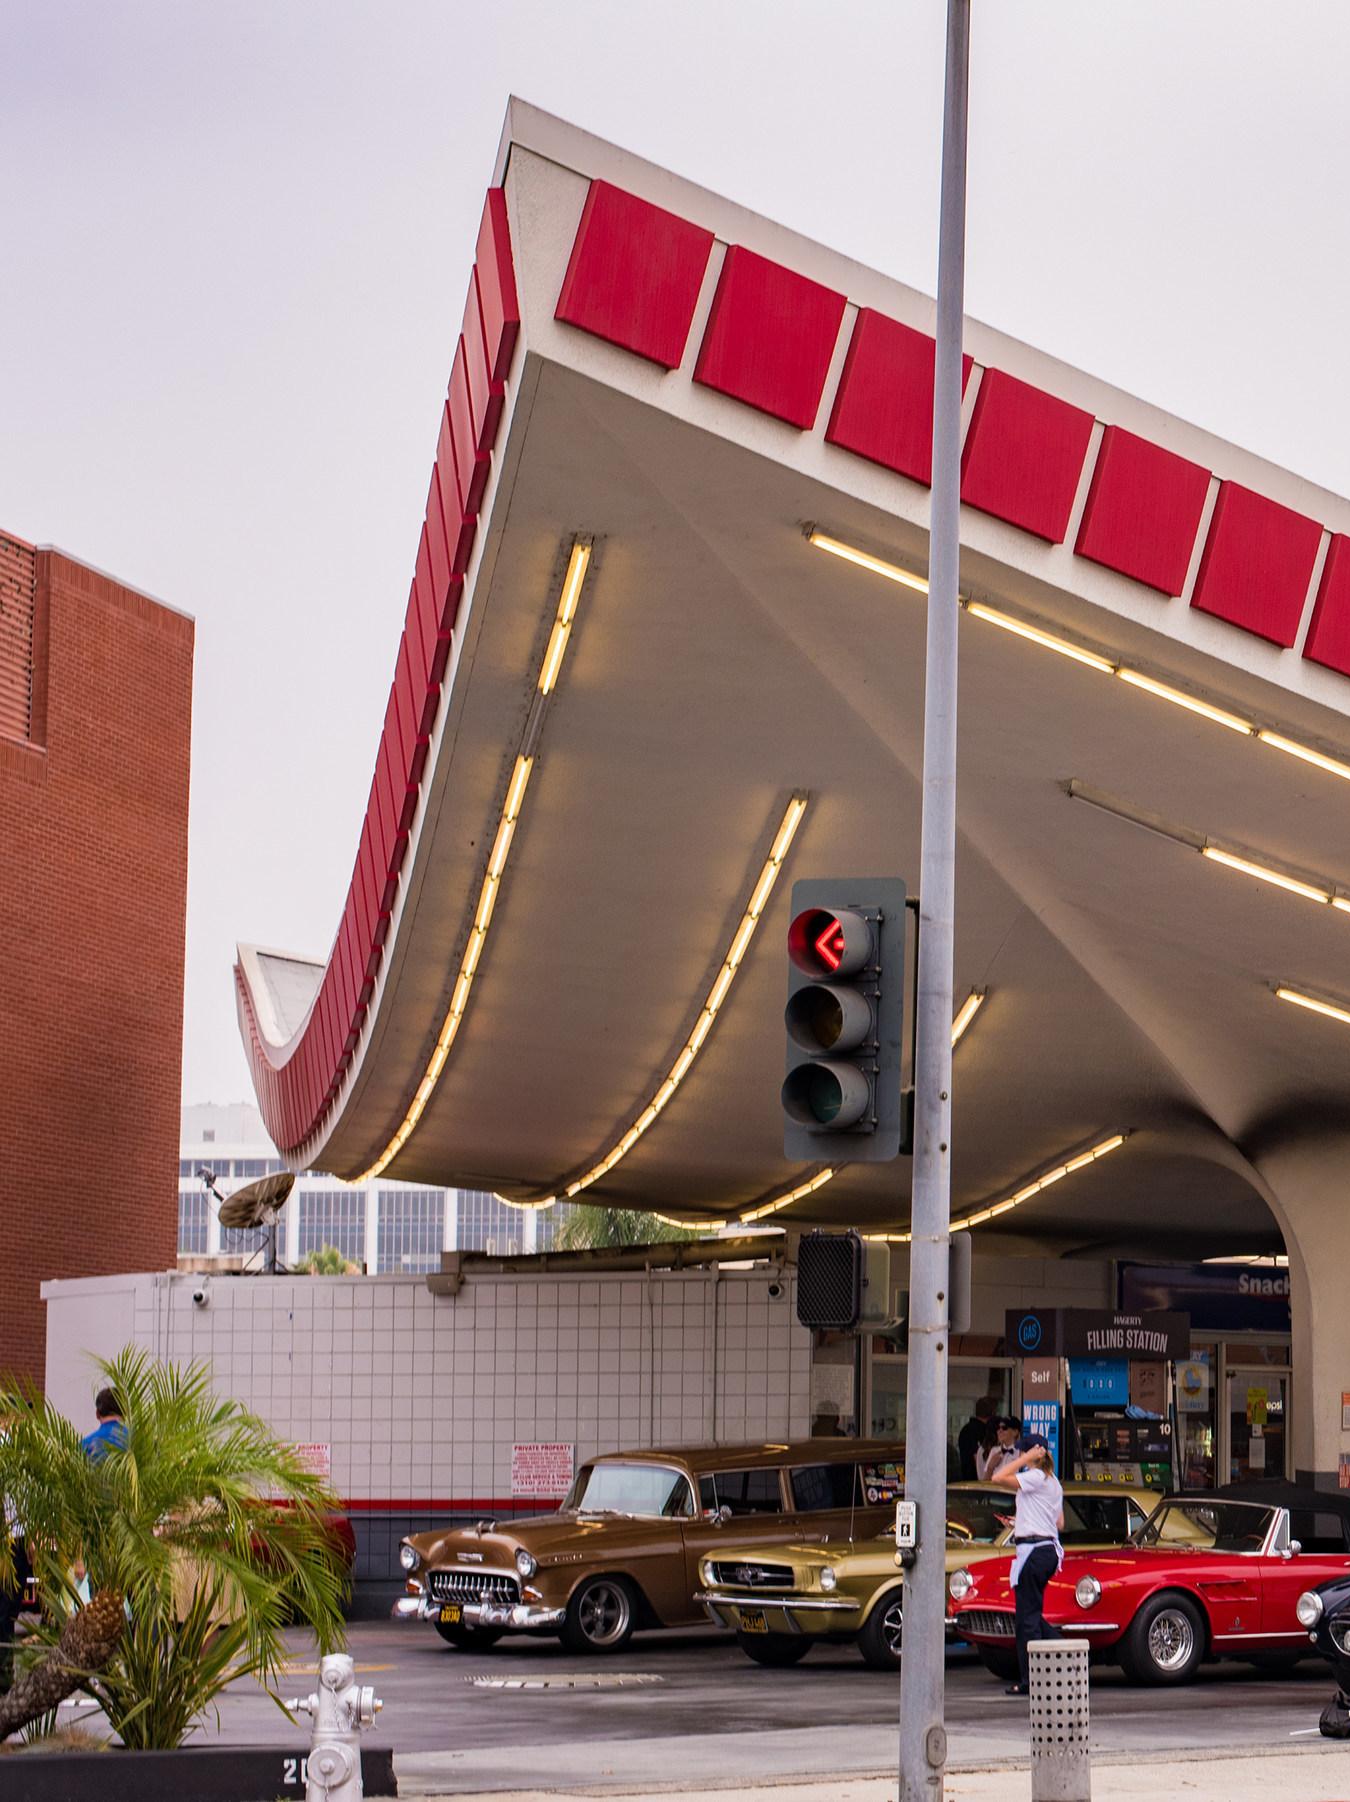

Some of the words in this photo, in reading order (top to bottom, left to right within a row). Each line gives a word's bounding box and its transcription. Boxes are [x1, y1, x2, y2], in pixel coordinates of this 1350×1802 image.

[1114, 1316, 1143, 1326] HAGERTY
[1023, 1324, 1037, 1341] GAS
[1087, 1329, 1124, 1351] FILLING
[1125, 1329, 1169, 1353] STATION
[1192, 1351, 1203, 1361] AY
[1031, 1371, 1051, 1384] Self
[1266, 1400, 1283, 1411] epsi
[1023, 1404, 1057, 1421] WRONG
[1030, 1422, 1051, 1438] WAY
[1159, 1423, 1171, 1435] 10
